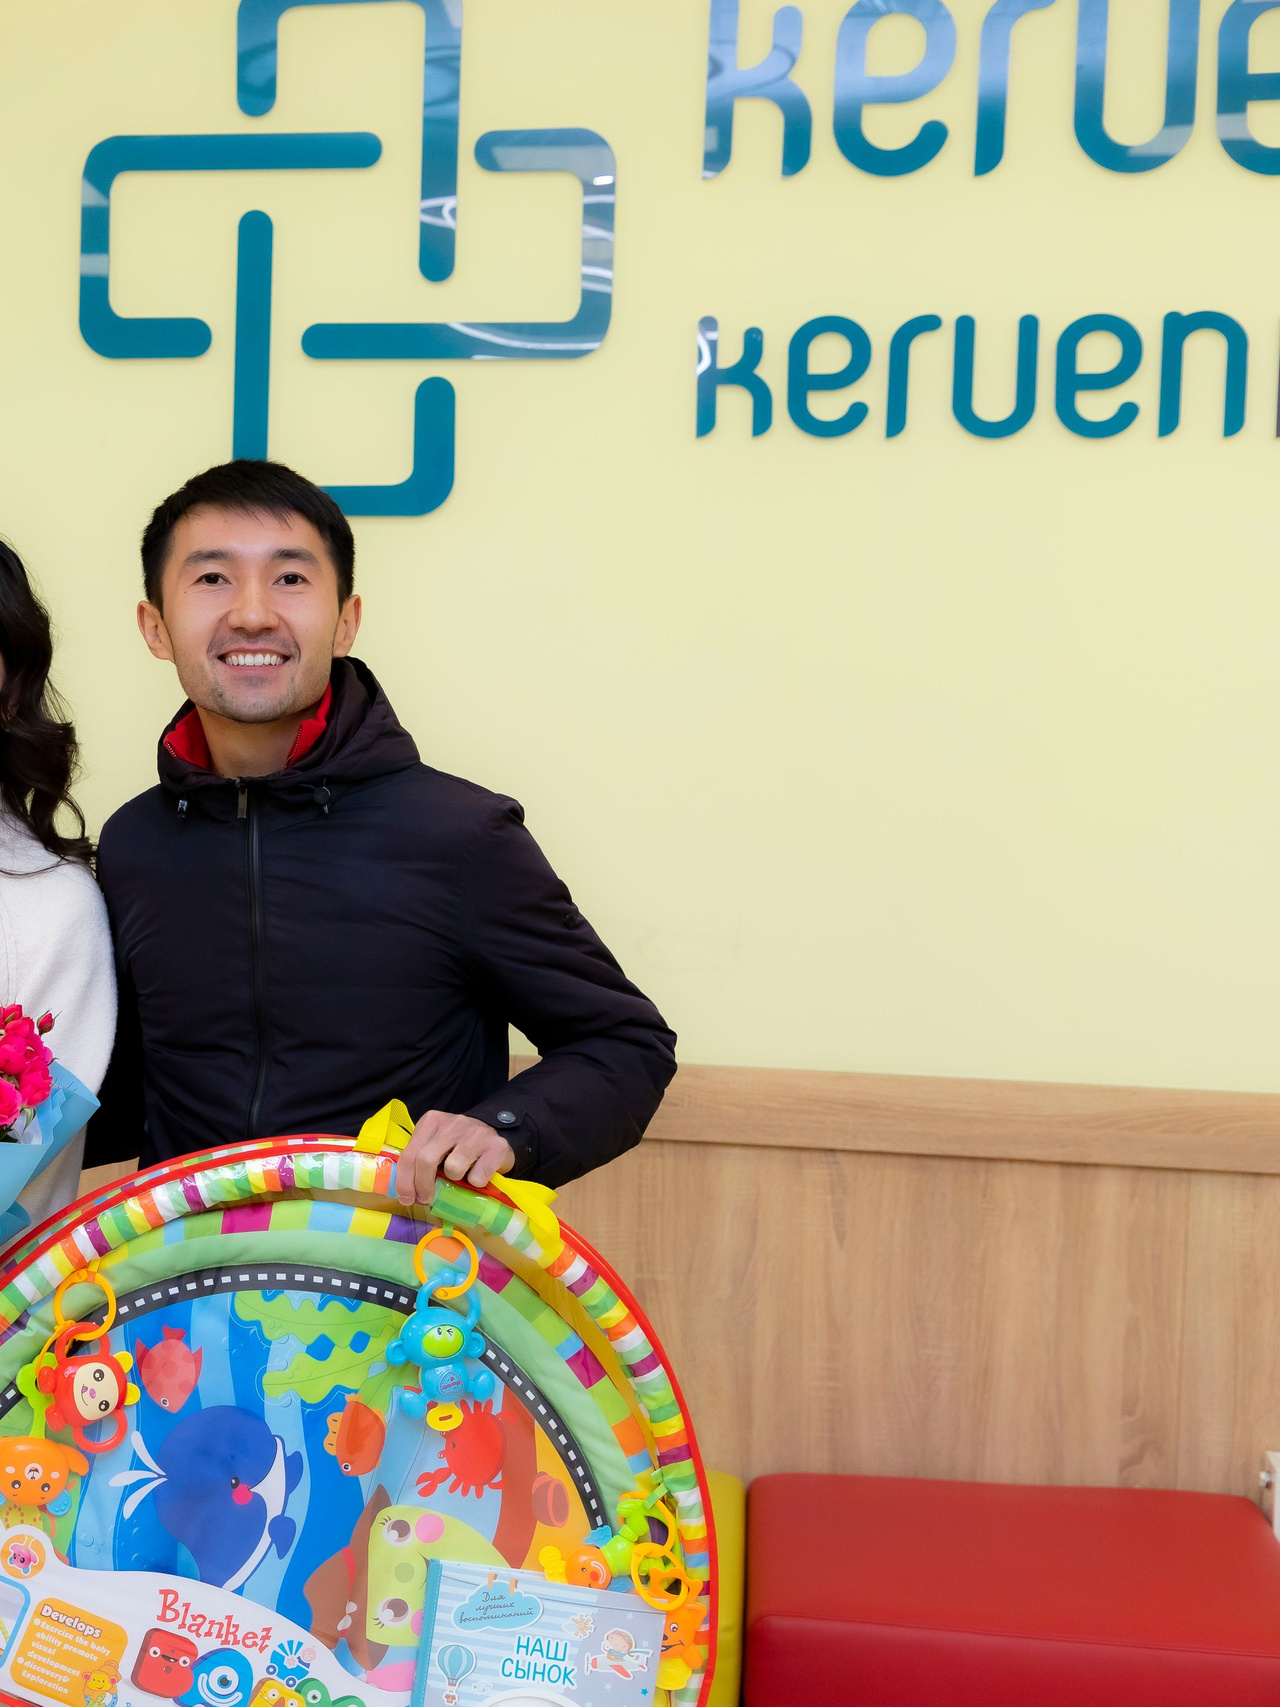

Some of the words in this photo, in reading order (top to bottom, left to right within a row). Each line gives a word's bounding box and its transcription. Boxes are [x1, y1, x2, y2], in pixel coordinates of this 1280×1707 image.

[476, 1602, 515, 1615] лучших
[482, 1592, 506, 1602] Для
[40, 1604, 102, 1638] Develops
[157, 1589, 272, 1654] Blanket
[460, 1608, 534, 1623] воспоминаний
[31, 1641, 56, 1655] visual
[35, 1632, 62, 1647] ability
[63, 1643, 98, 1662] promote
[40, 1621, 74, 1640] Exercise
[76, 1636, 89, 1646] the
[90, 1642, 111, 1656] baby
[516, 1636, 568, 1661] НАШ
[27, 1651, 80, 1676] development
[501, 1658, 575, 1686] СЫНОК
[21, 1670, 69, 1694] Exploration
